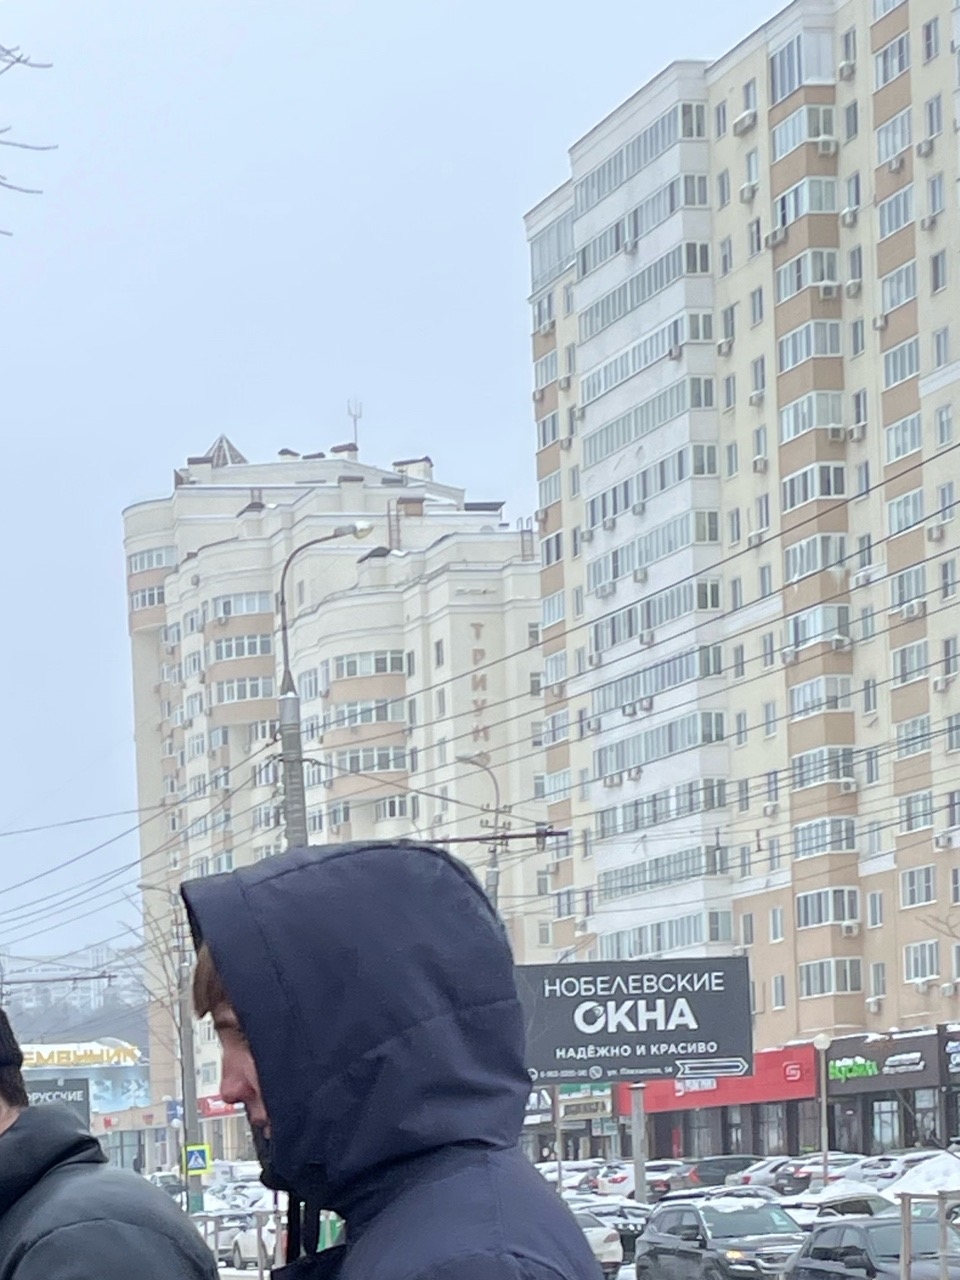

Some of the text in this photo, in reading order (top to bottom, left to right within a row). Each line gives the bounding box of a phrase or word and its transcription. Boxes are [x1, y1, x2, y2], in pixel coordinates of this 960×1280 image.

[544, 972, 725, 997] НОБЕЛЕВСКИЕ
[573, 998, 698, 1034] ОКНА
[555, 1041, 718, 1060] НАДЁЖНО И КРАСИВО
